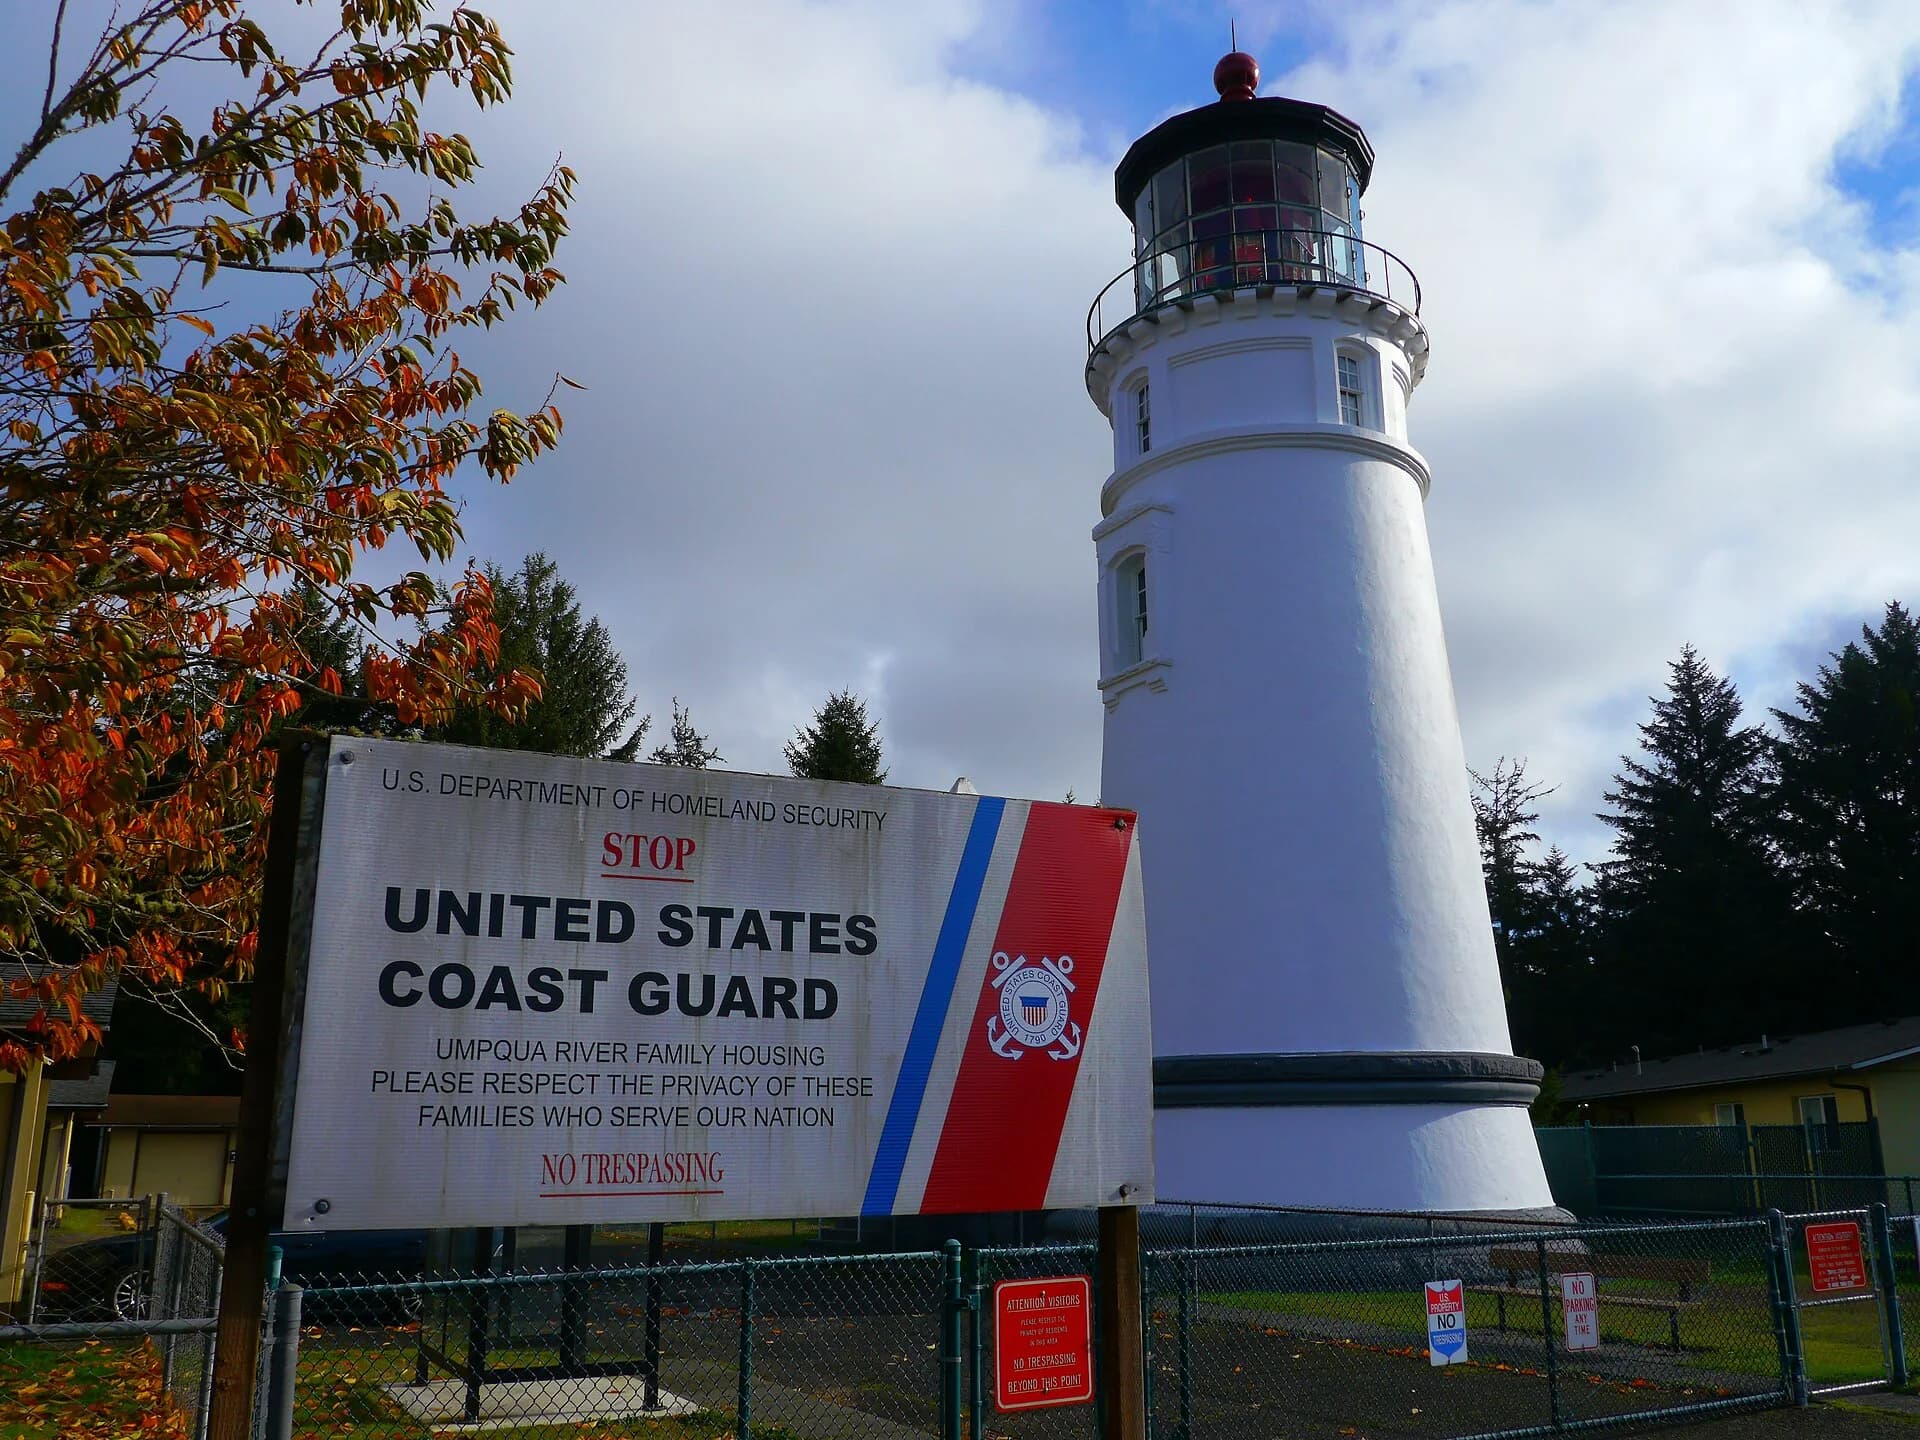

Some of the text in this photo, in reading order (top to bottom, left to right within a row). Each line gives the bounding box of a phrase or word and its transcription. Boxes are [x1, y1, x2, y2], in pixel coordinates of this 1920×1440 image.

[383, 768, 887, 831] U.S. DEPARTMENT OF HOMELAND SECURITY
[601, 832, 696, 871] STOP
[384, 886, 878, 956] UNITED STATES
[378, 960, 839, 1020] COAST GUARD
[1002, 969, 1067, 1036] UNITED STATES COAST GUARD
[1024, 1033, 1046, 1044] 1790
[436, 1038, 825, 1066] UMPQUA RIVER FAMILY HOUSING
[371, 1070, 873, 1097] PLEASE RESPECT THE PRIVACY OF THESE
[418, 1105, 834, 1127] FAMILIES WHO SERVE OUR NATION
[541, 1151, 724, 1185] NO TRESPASSING
[1571, 1280, 1585, 1295] NO
[1007, 1294, 1080, 1311] ATTENTION VISITORS
[1430, 1301, 1459, 1313] PROPERTY
[1565, 1297, 1595, 1312] PARKING
[1437, 1313, 1456, 1329] NO
[1575, 1313, 1588, 1324] ANY
[1574, 1324, 1590, 1335] TIME
[1433, 1332, 1463, 1345] TRESPASSING
[1013, 1352, 1076, 1369] NO TRESPASSING
[1008, 1374, 1081, 1392] BEYOND THIS POINT
